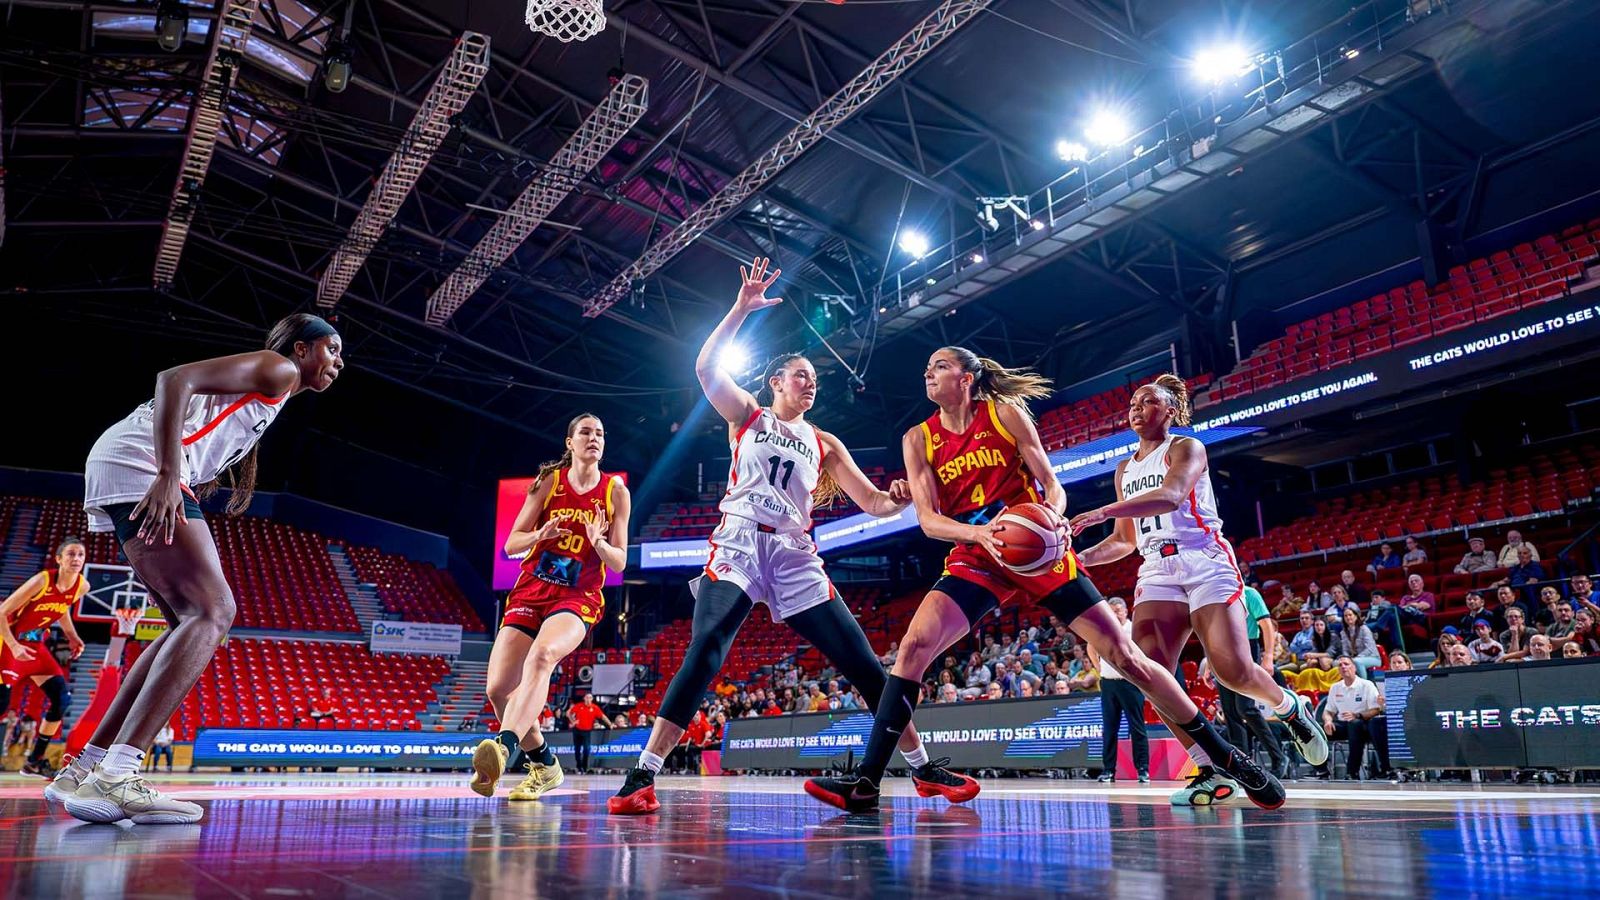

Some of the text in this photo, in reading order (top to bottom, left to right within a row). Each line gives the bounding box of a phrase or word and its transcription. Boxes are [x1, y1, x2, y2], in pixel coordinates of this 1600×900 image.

[1410, 355, 1432, 370] THE
[1434, 346, 1463, 363] CATS
[1464, 332, 1510, 355] WOULD
[1511, 322, 1545, 340] LOVE
[1545, 317, 1564, 330] TO
[1566, 308, 1593, 324] SEE
[1193, 372, 1378, 433] THE CATS WOULD LOVE TO SEE YOU AGAIN.
[754, 431, 813, 464] CANADA
[768, 455, 795, 491] 11
[937, 446, 1007, 485] ESPAÑA
[763, 498, 782, 512] Sun
[970, 484, 986, 506] 4
[558, 532, 584, 554] 30
[38, 617, 51, 626] 7
[1435, 708, 1501, 728] THE
[730, 740, 740, 749] THE
[755, 738, 779, 748] WOULD
[778, 737, 795, 748] LOVE
[796, 736, 805, 747] TO
[806, 736, 820, 746] SEE
[820, 736, 836, 746] YOU
[836, 734, 864, 746] AGAIN.
[933, 730, 969, 742] WOULD
[970, 728, 997, 742] LOVE
[999, 728, 1013, 740] TO
[1014, 727, 1036, 740] SEE
[1038, 726, 1062, 739] YOU
[217, 743, 246, 752] THE
[250, 744, 286, 752] CATS
[290, 744, 343, 754] WOULD
[346, 744, 380, 754] LOVE
[383, 745, 402, 754] TO
[404, 745, 429, 754] SEE
[432, 746, 460, 754] YOU
